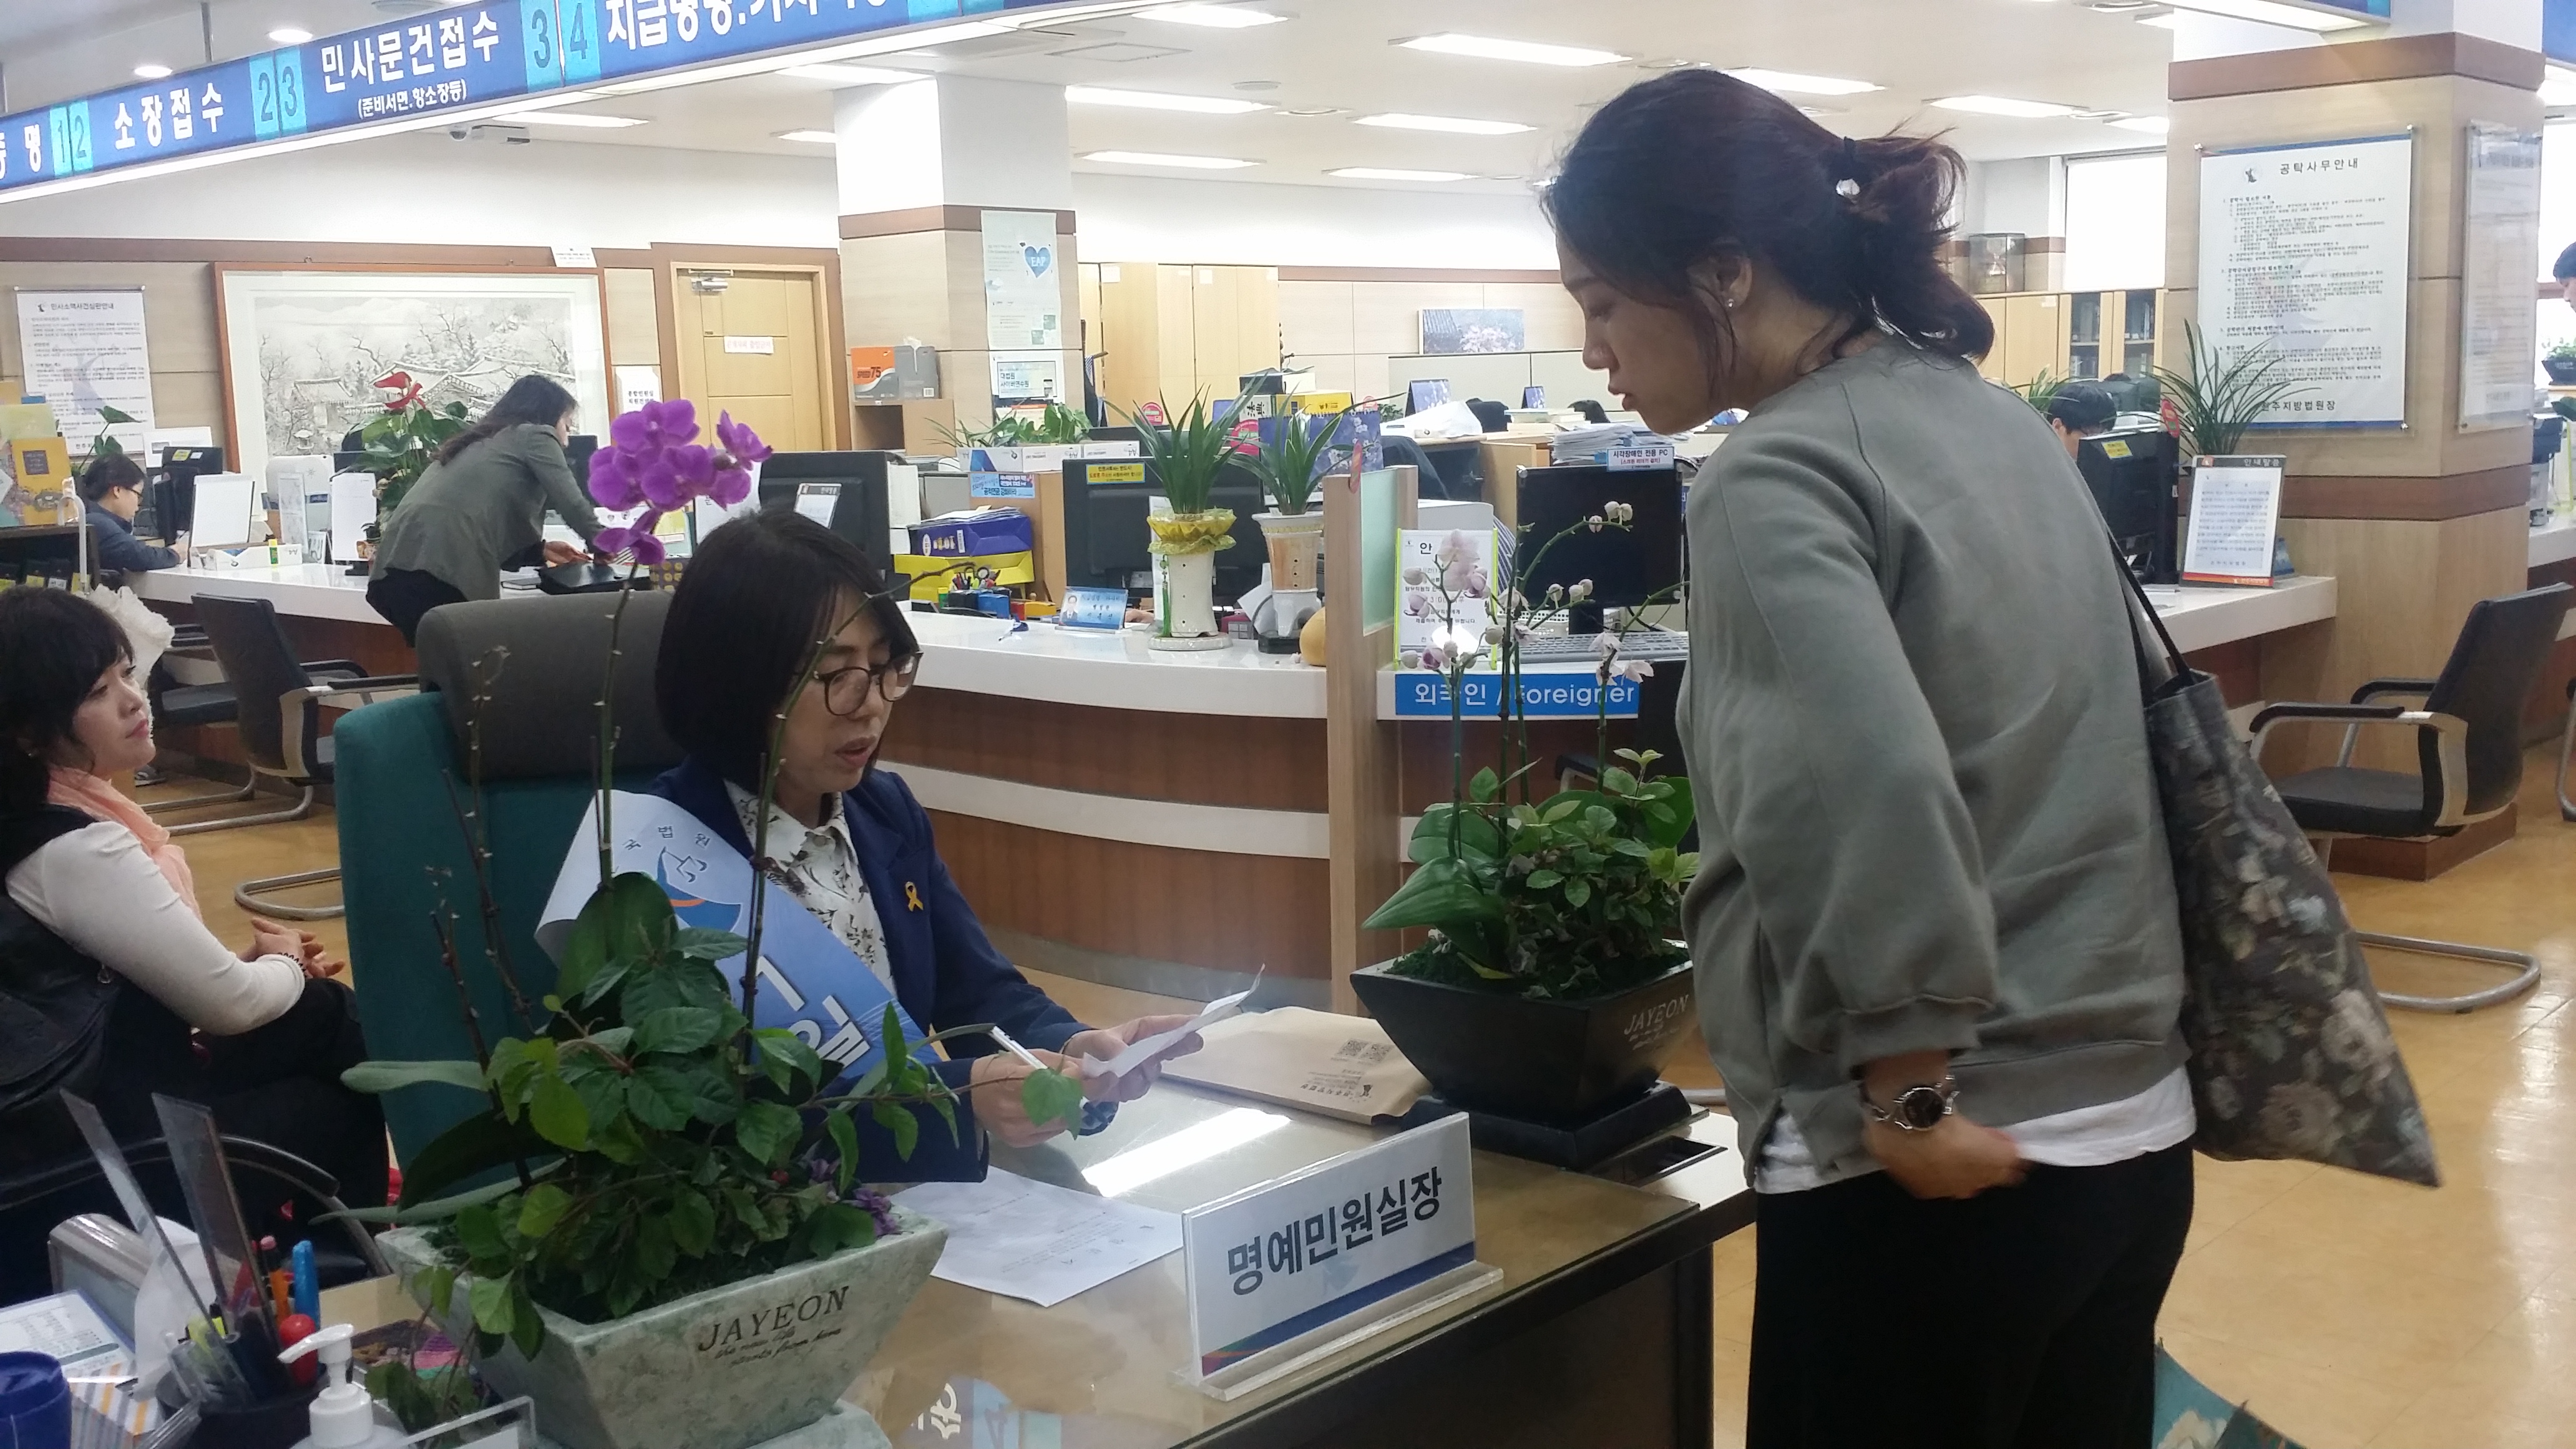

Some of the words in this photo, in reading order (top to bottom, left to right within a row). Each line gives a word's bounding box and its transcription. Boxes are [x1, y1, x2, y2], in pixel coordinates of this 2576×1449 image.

[321, 9, 500, 94] 민사문건접수
[530, 9, 551, 69] 3
[569, 12, 587, 61] 4
[257, 72, 274, 121] 2
[281, 66, 299, 116] 3
[74, 115, 87, 160] 2
[114, 82, 225, 150] 소장접수
[57, 120, 69, 164] 1
[2280, 157, 2359, 176] 공탁사무안내
[1613, 449, 1642, 458] 시각장애인
[1645, 449, 1656, 457] 전용
[1623, 993, 1689, 1035] JAYEON
[1227, 1166, 1443, 1297] 명예민원실장
[697, 1285, 850, 1352] JAYEON
